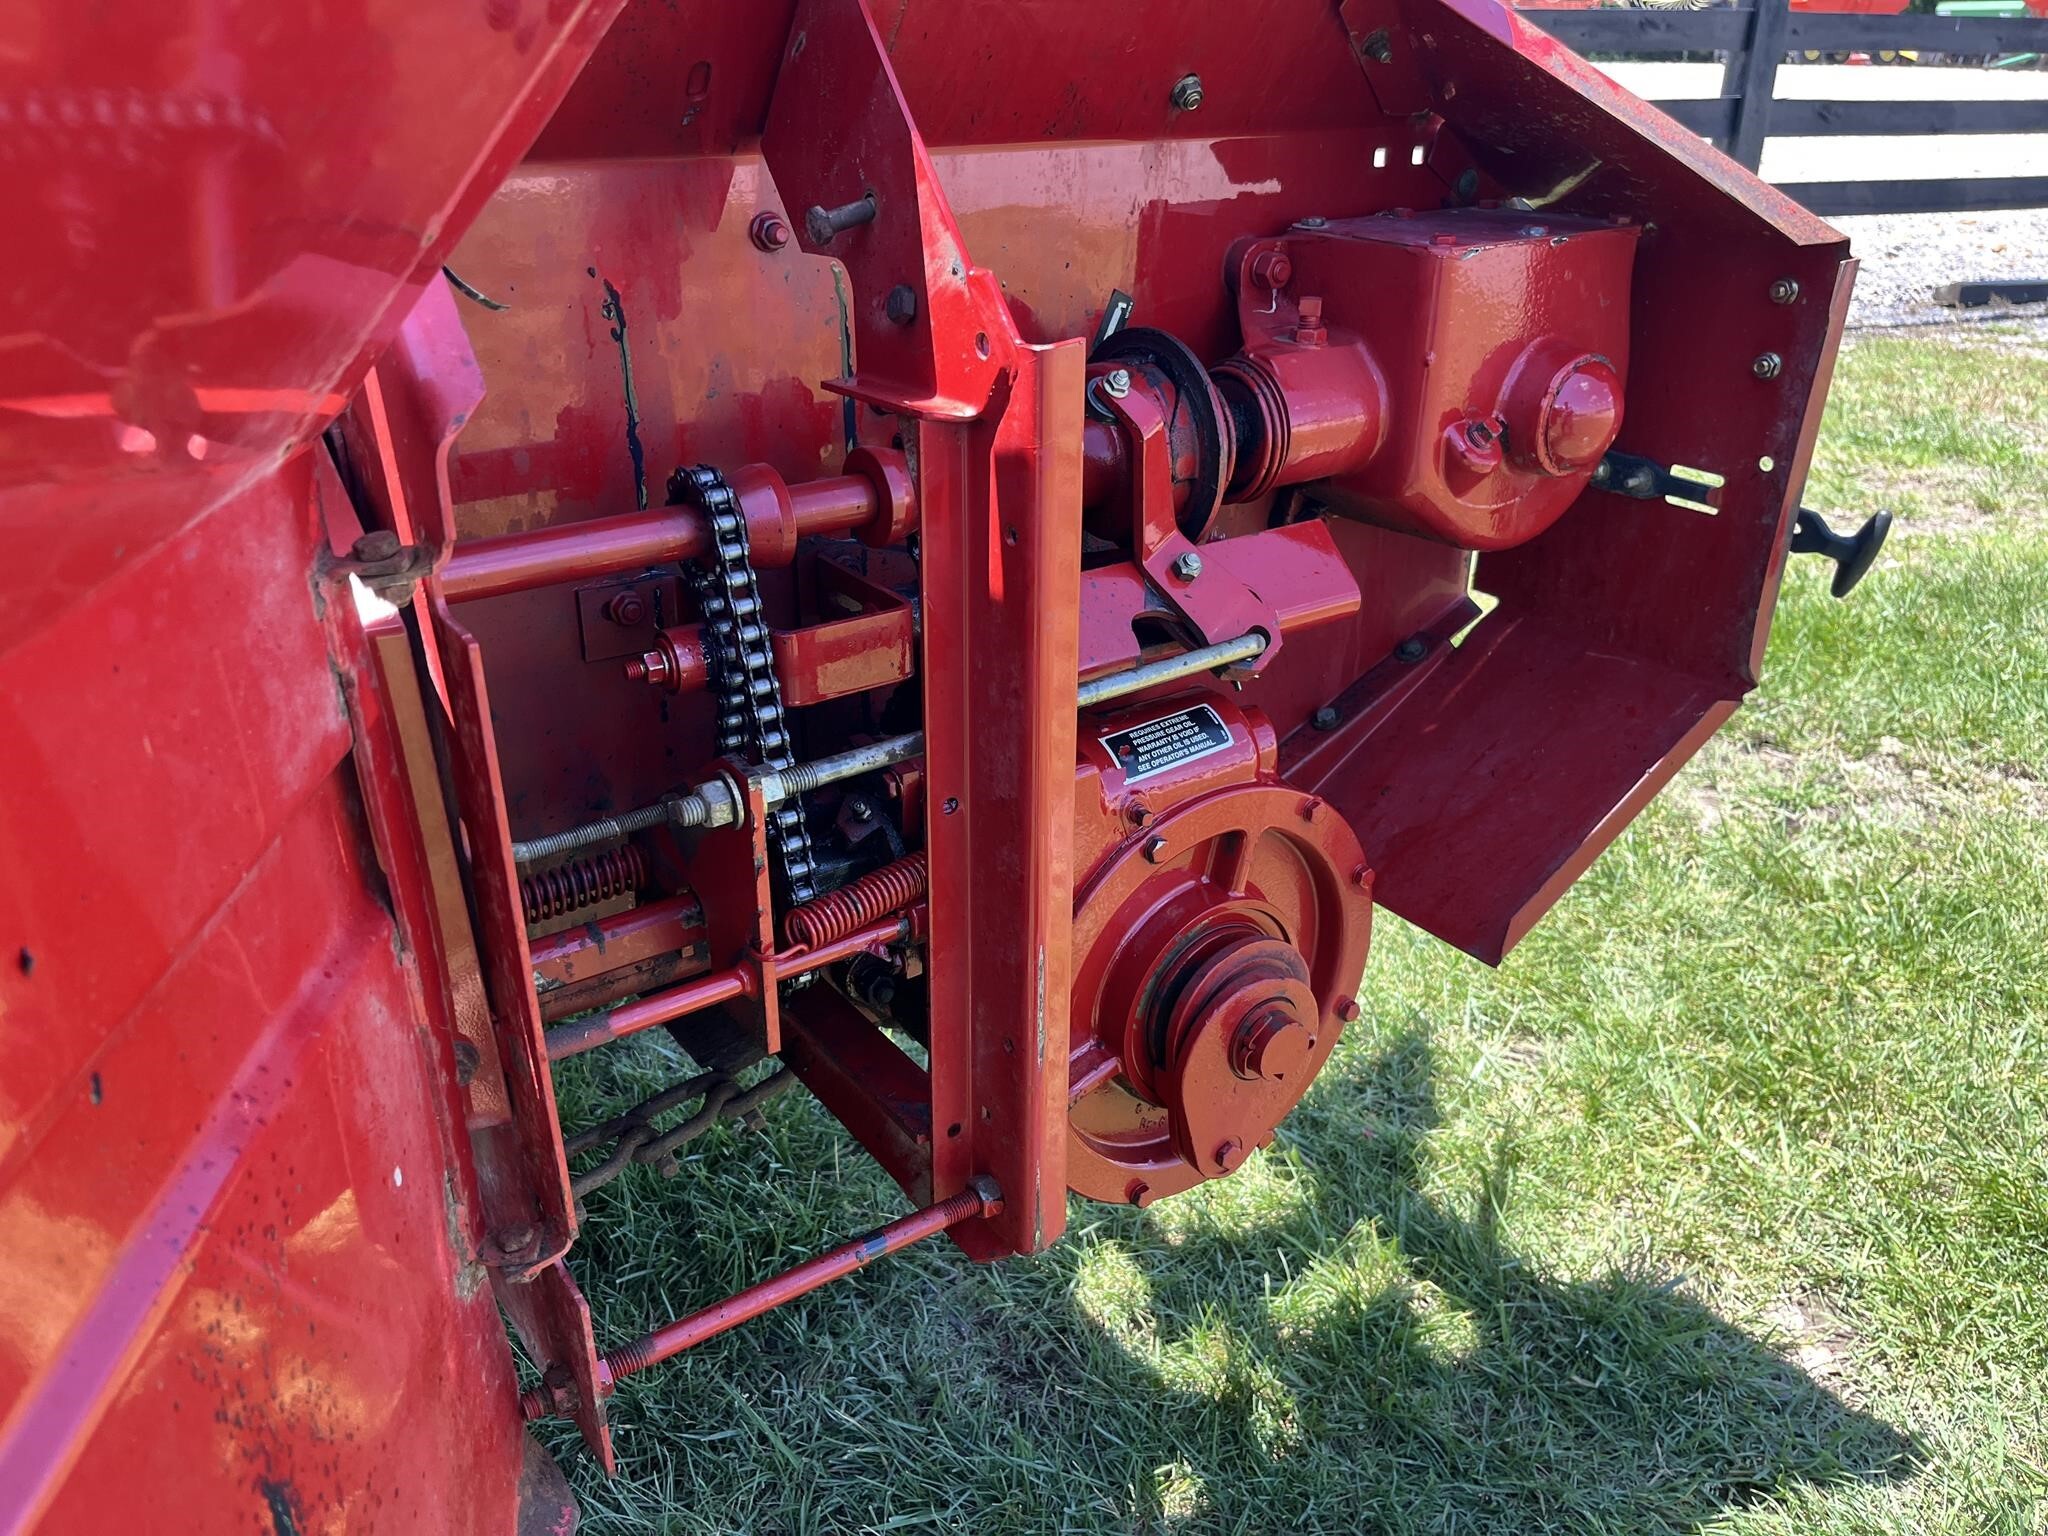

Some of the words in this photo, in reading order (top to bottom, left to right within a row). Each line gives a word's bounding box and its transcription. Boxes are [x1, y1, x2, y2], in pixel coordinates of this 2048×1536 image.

[1129, 725, 1160, 738] REQUIRES
[1160, 715, 1189, 727] EXTREME
[1133, 730, 1166, 746] PRESSURE
[1166, 726, 1184, 734] GEAR
[1137, 737, 1172, 753] WARRANTY
[1178, 729, 1193, 737] VOID
[1138, 754, 1152, 762] ANY
[1152, 746, 1173, 757] OTHER
[1190, 733, 1209, 742] USED.
[1138, 763, 1151, 772] SEE
[1152, 749, 1189, 767] OPERATOR'S
[1190, 740, 1216, 752] MANUAL.
